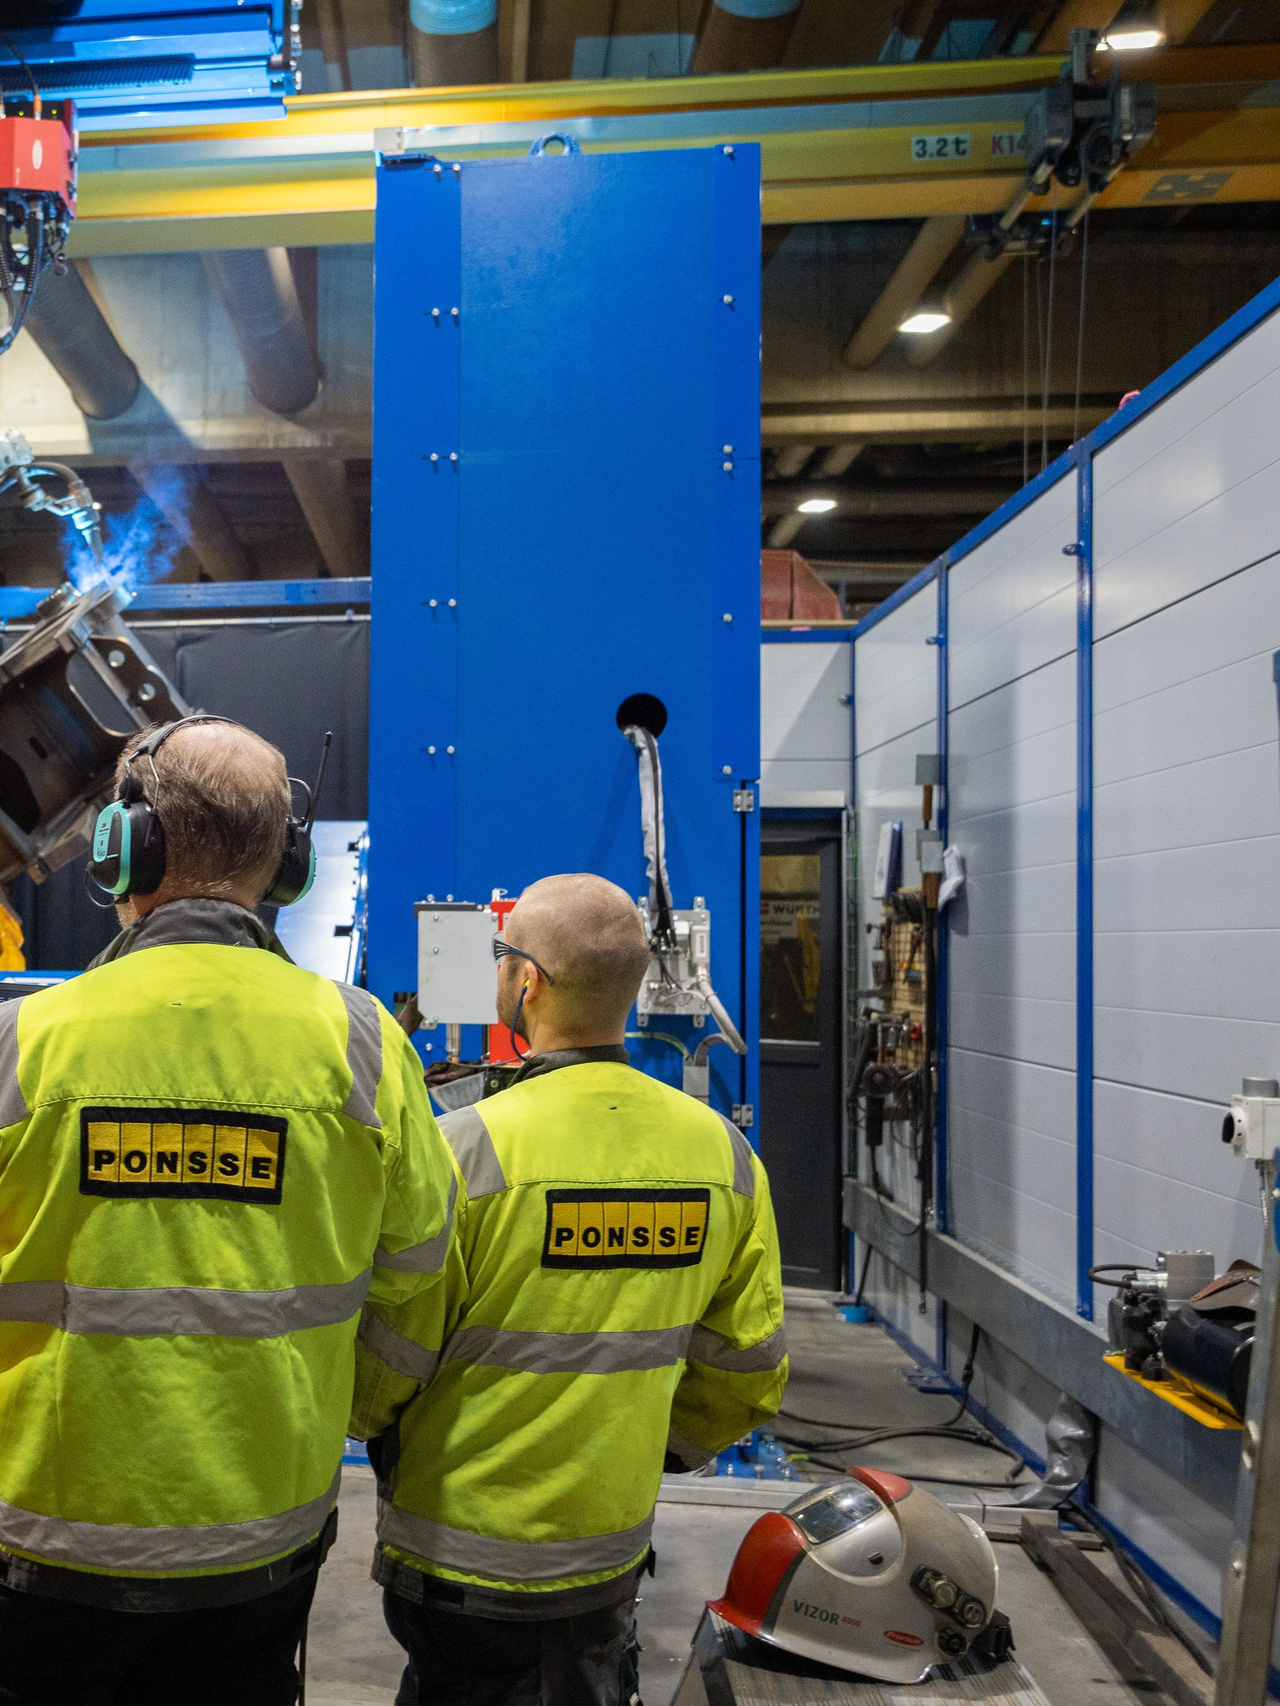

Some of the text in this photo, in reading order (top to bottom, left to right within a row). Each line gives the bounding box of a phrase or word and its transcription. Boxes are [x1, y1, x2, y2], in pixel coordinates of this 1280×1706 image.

[93, 1149, 273, 1180] PONSSE
[554, 1226, 701, 1248] PONSSE
[793, 1600, 840, 1626] VIZOR
[885, 1631, 922, 1644] Fronius
